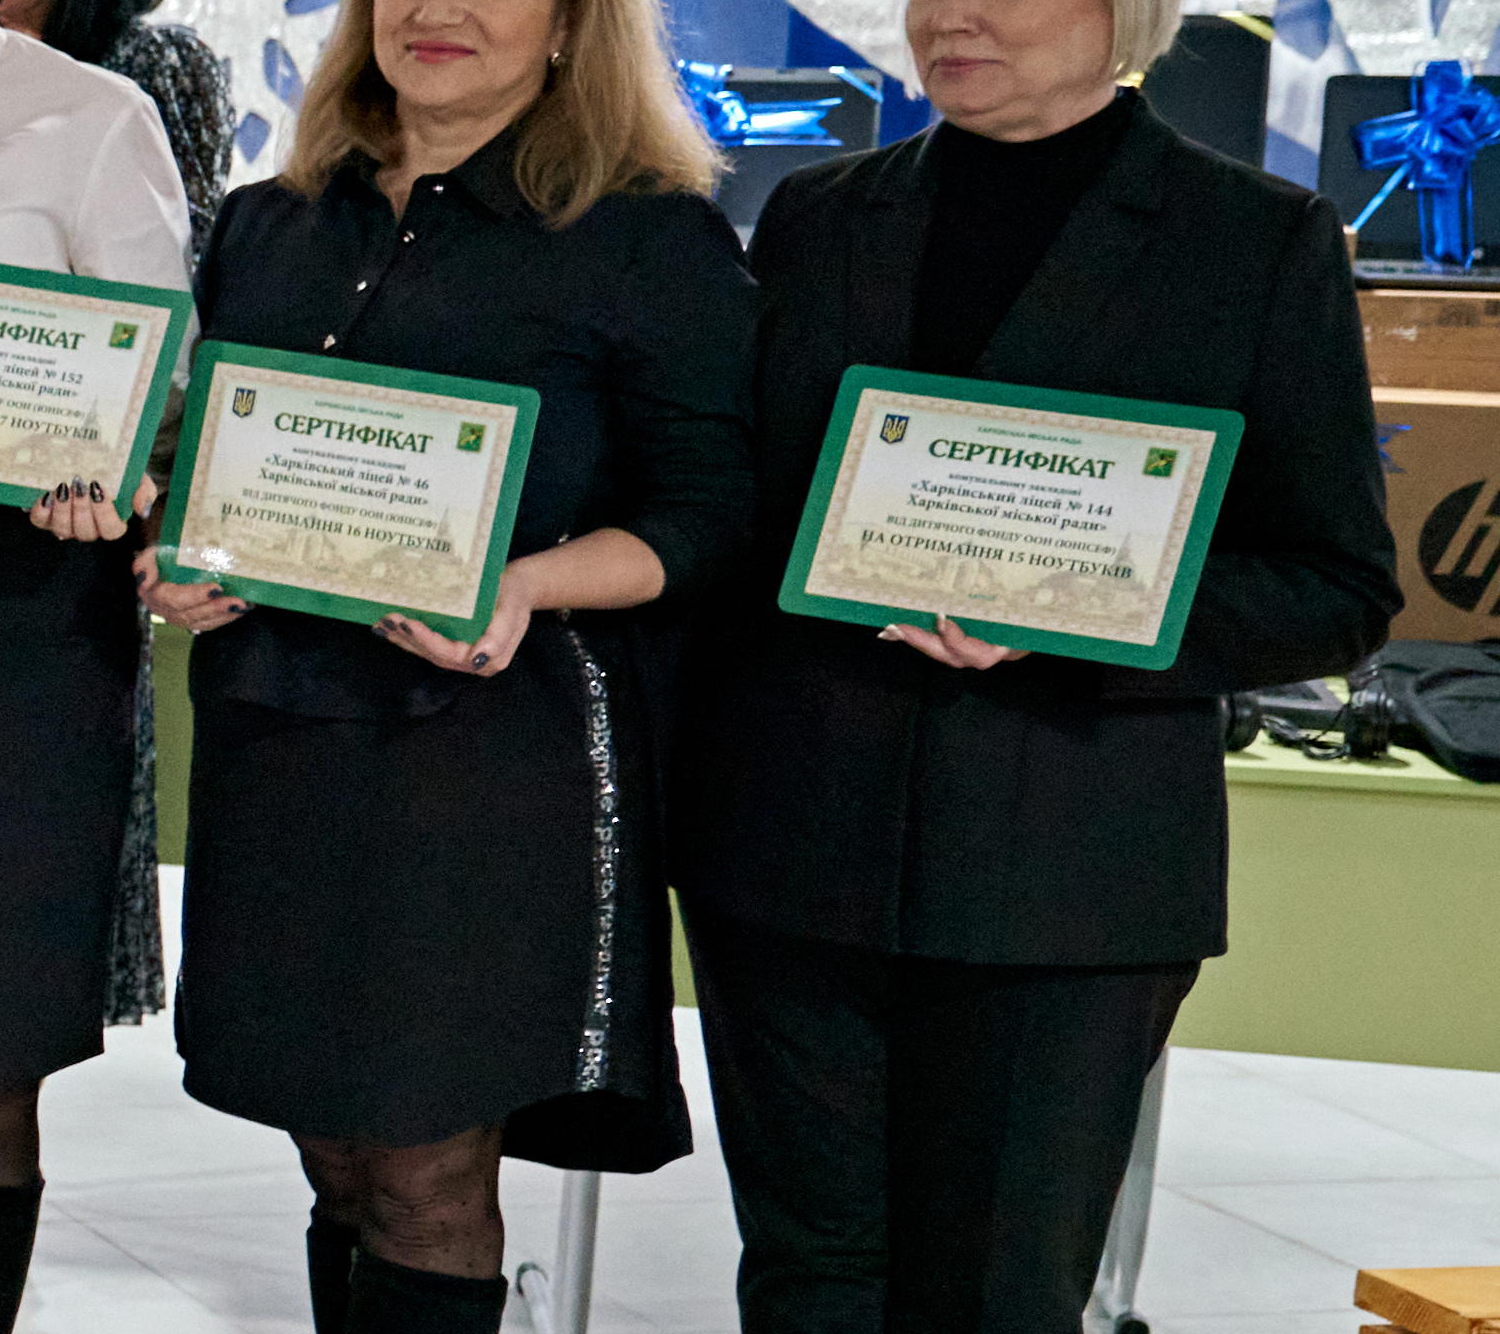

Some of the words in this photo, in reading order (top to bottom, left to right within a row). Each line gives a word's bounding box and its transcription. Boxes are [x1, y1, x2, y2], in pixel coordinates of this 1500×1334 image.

[3, 363, 40, 378] ліцей
[60, 371, 83, 385] 152
[10, 416, 98, 441] НОУТБУКІВ
[274, 412, 434, 454] СЕРТИФІКАТ
[264, 453, 355, 479] «Харківський
[357, 469, 394, 485] ліцей
[928, 438, 1116, 480] СЕРТИФІКАТ
[258, 467, 337, 492] Харківської
[339, 482, 388, 500] міської
[910, 479, 1016, 505] «Харківський
[1019, 494, 1062, 510] ліцей
[1087, 503, 1113, 517] 144
[245, 507, 343, 534] ОТРИМАННЯ
[364, 527, 451, 553] НОУТБУКІВ
[886, 515, 907, 527] ВІД
[976, 528, 1022, 542] ФОНДУ
[1023, 534, 1053, 546] ООН
[906, 493, 1000, 518] Харківської
[1001, 508, 1059, 526] міської
[1060, 518, 1107, 532] ради»
[889, 534, 1004, 561] ОТРИМАННЯ
[1028, 553, 1132, 579] НОУТБУКІВ
[1426, 479, 1500, 613] h
